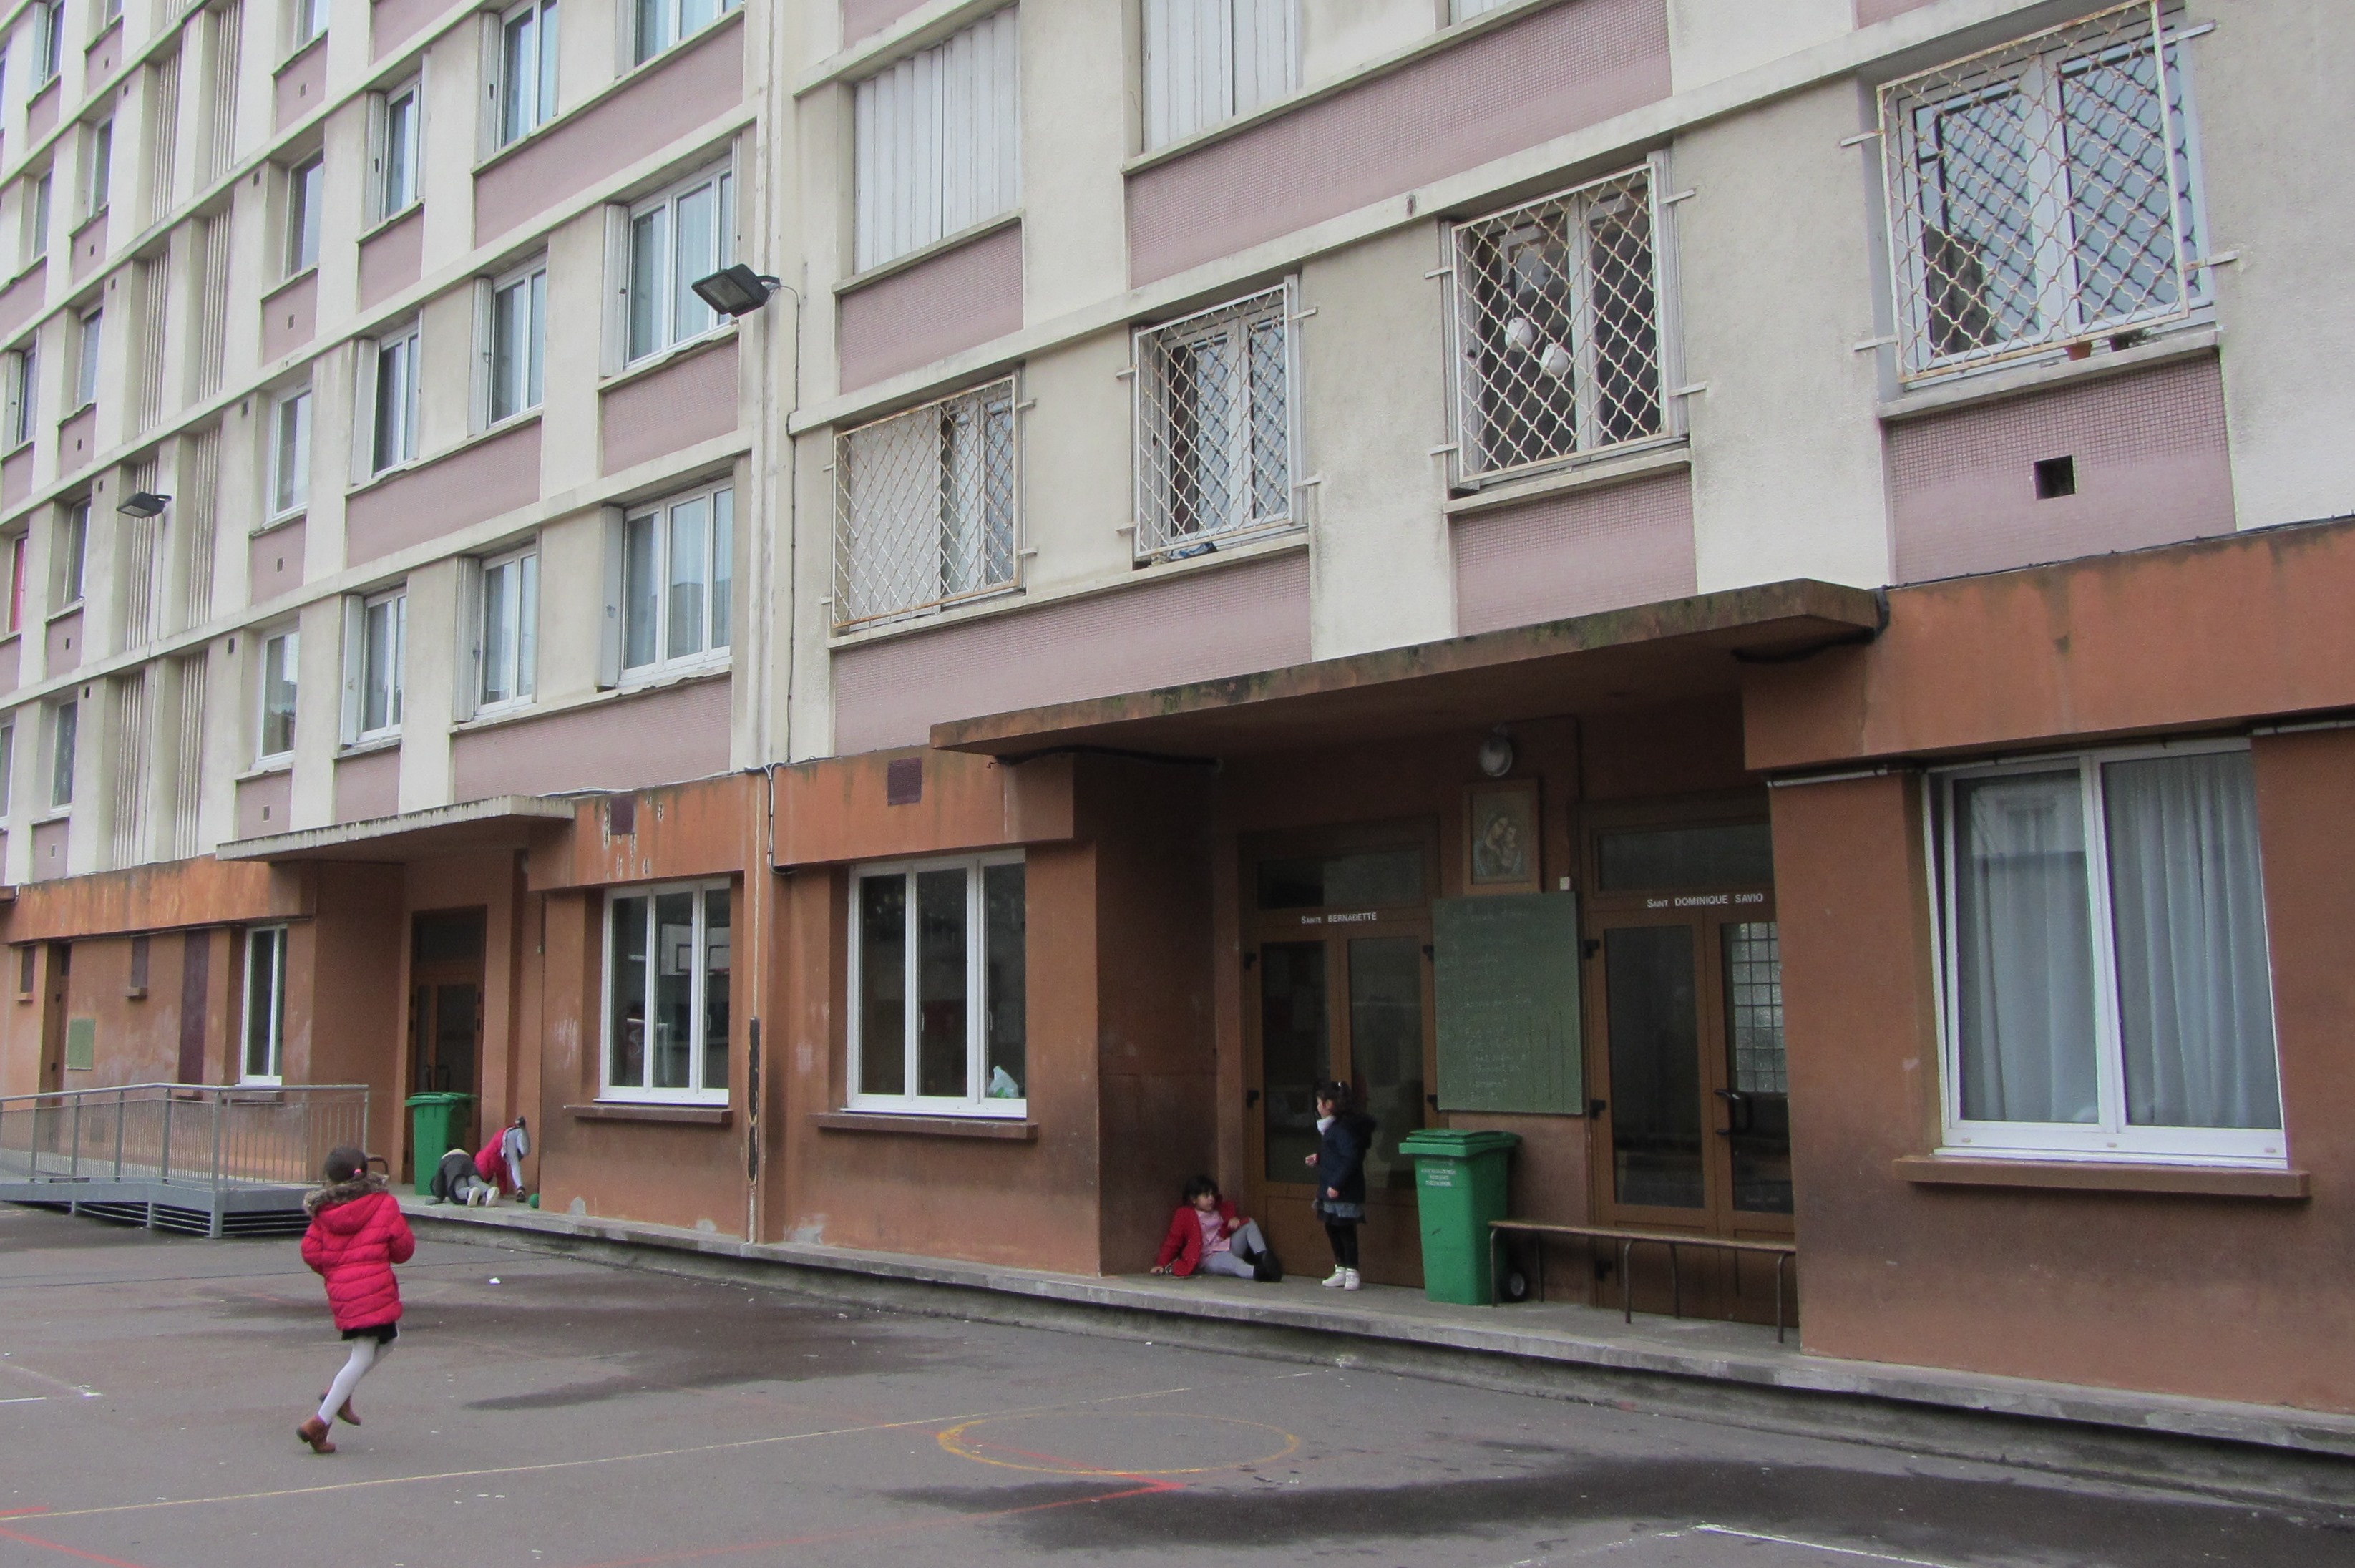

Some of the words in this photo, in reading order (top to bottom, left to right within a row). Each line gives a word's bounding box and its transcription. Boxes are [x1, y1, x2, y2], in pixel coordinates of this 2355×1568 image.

[1674, 895, 1728, 907] DOMINIQUE
[1735, 892, 1763, 903] SAVIO
[1327, 912, 1377, 923] BERNADETTE
